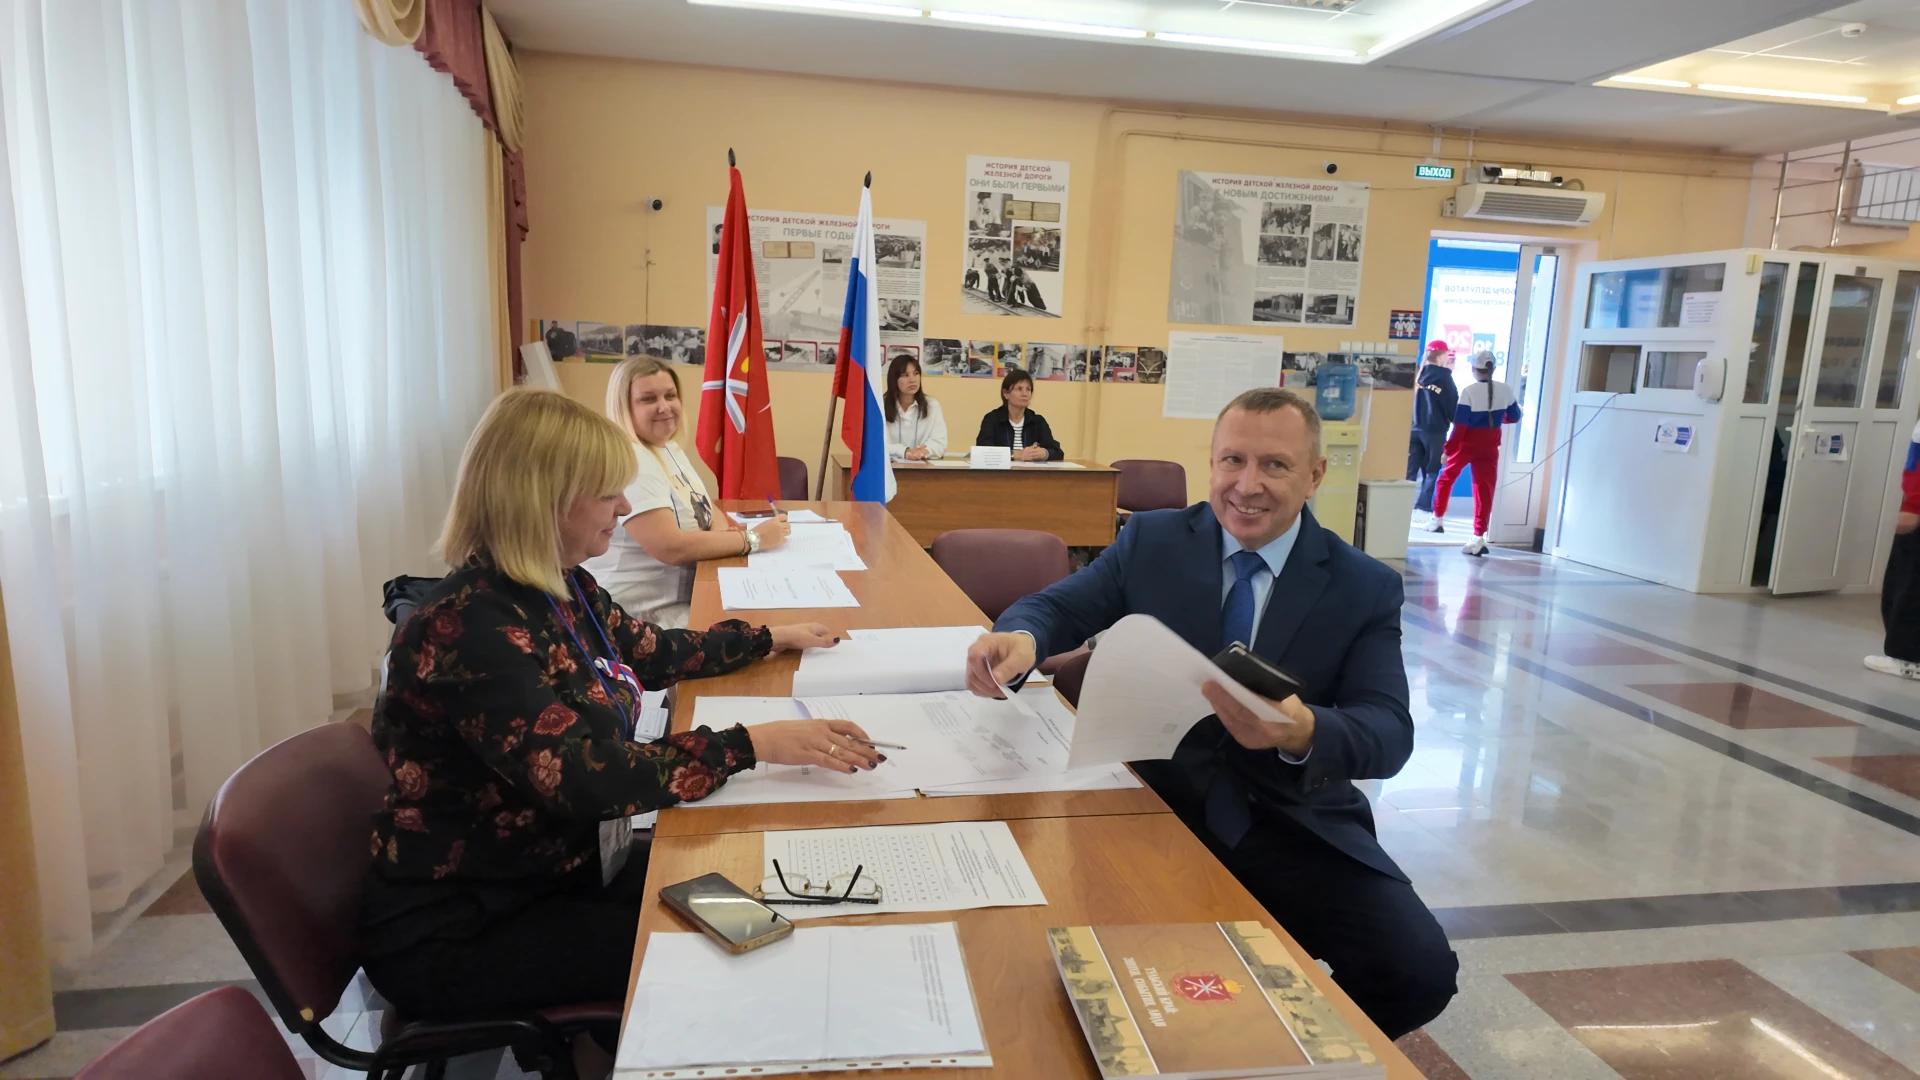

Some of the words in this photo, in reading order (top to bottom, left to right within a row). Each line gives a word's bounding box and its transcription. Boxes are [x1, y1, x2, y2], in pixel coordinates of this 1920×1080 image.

[985, 162, 1018, 170] ИСТОРИЯ
[1020, 164, 1051, 172] ДЕТСКОЙ
[1419, 166, 1452, 178] ВЫХОД
[984, 170, 1022, 178] ЖЕЛЕЗНОЙ
[1024, 172, 1052, 181] ДОРОГИ
[969, 178, 990, 188] ОНИ
[992, 179, 1019, 190] БЫЛИ
[1021, 182, 1065, 192] ПЕРВЫМИ
[1212, 178, 1242, 186] ИСТОРИЯ
[1275, 182, 1311, 190] ЖЕЛЕЗНОЙ
[1223, 189, 1258, 198] НОВЫМ
[782, 217, 816, 225] ДЕТСКОЙ
[818, 220, 858, 228] ЖЕЛЕЗНОЙ
[783, 227, 822, 238] ПЕРВЫЕ
[825, 230, 856, 240] ГОДЫ
